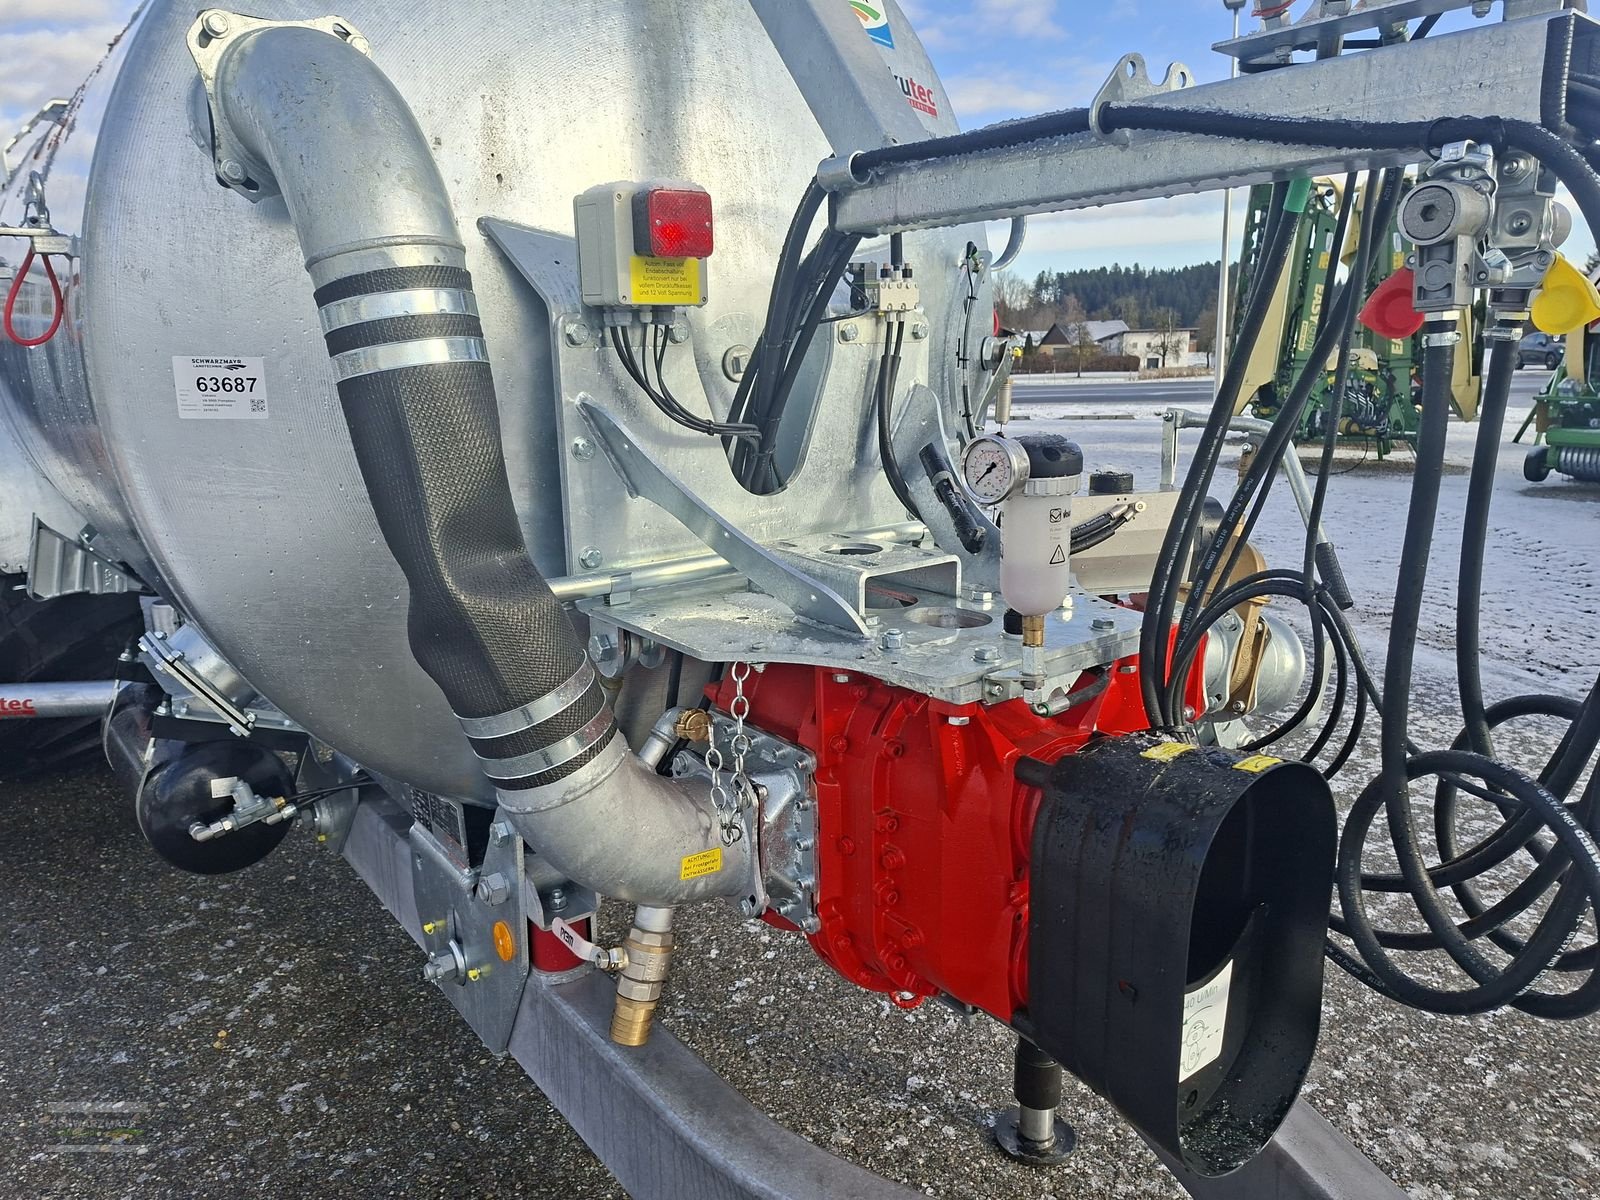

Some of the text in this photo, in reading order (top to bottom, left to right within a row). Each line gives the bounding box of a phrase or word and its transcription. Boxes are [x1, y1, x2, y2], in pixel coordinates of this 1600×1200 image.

[196, 377, 257, 393] 63687
[1515, 969, 1549, 996] WABCO
[1546, 954, 1561, 968] DIN
[1557, 931, 1576, 953] 74310
